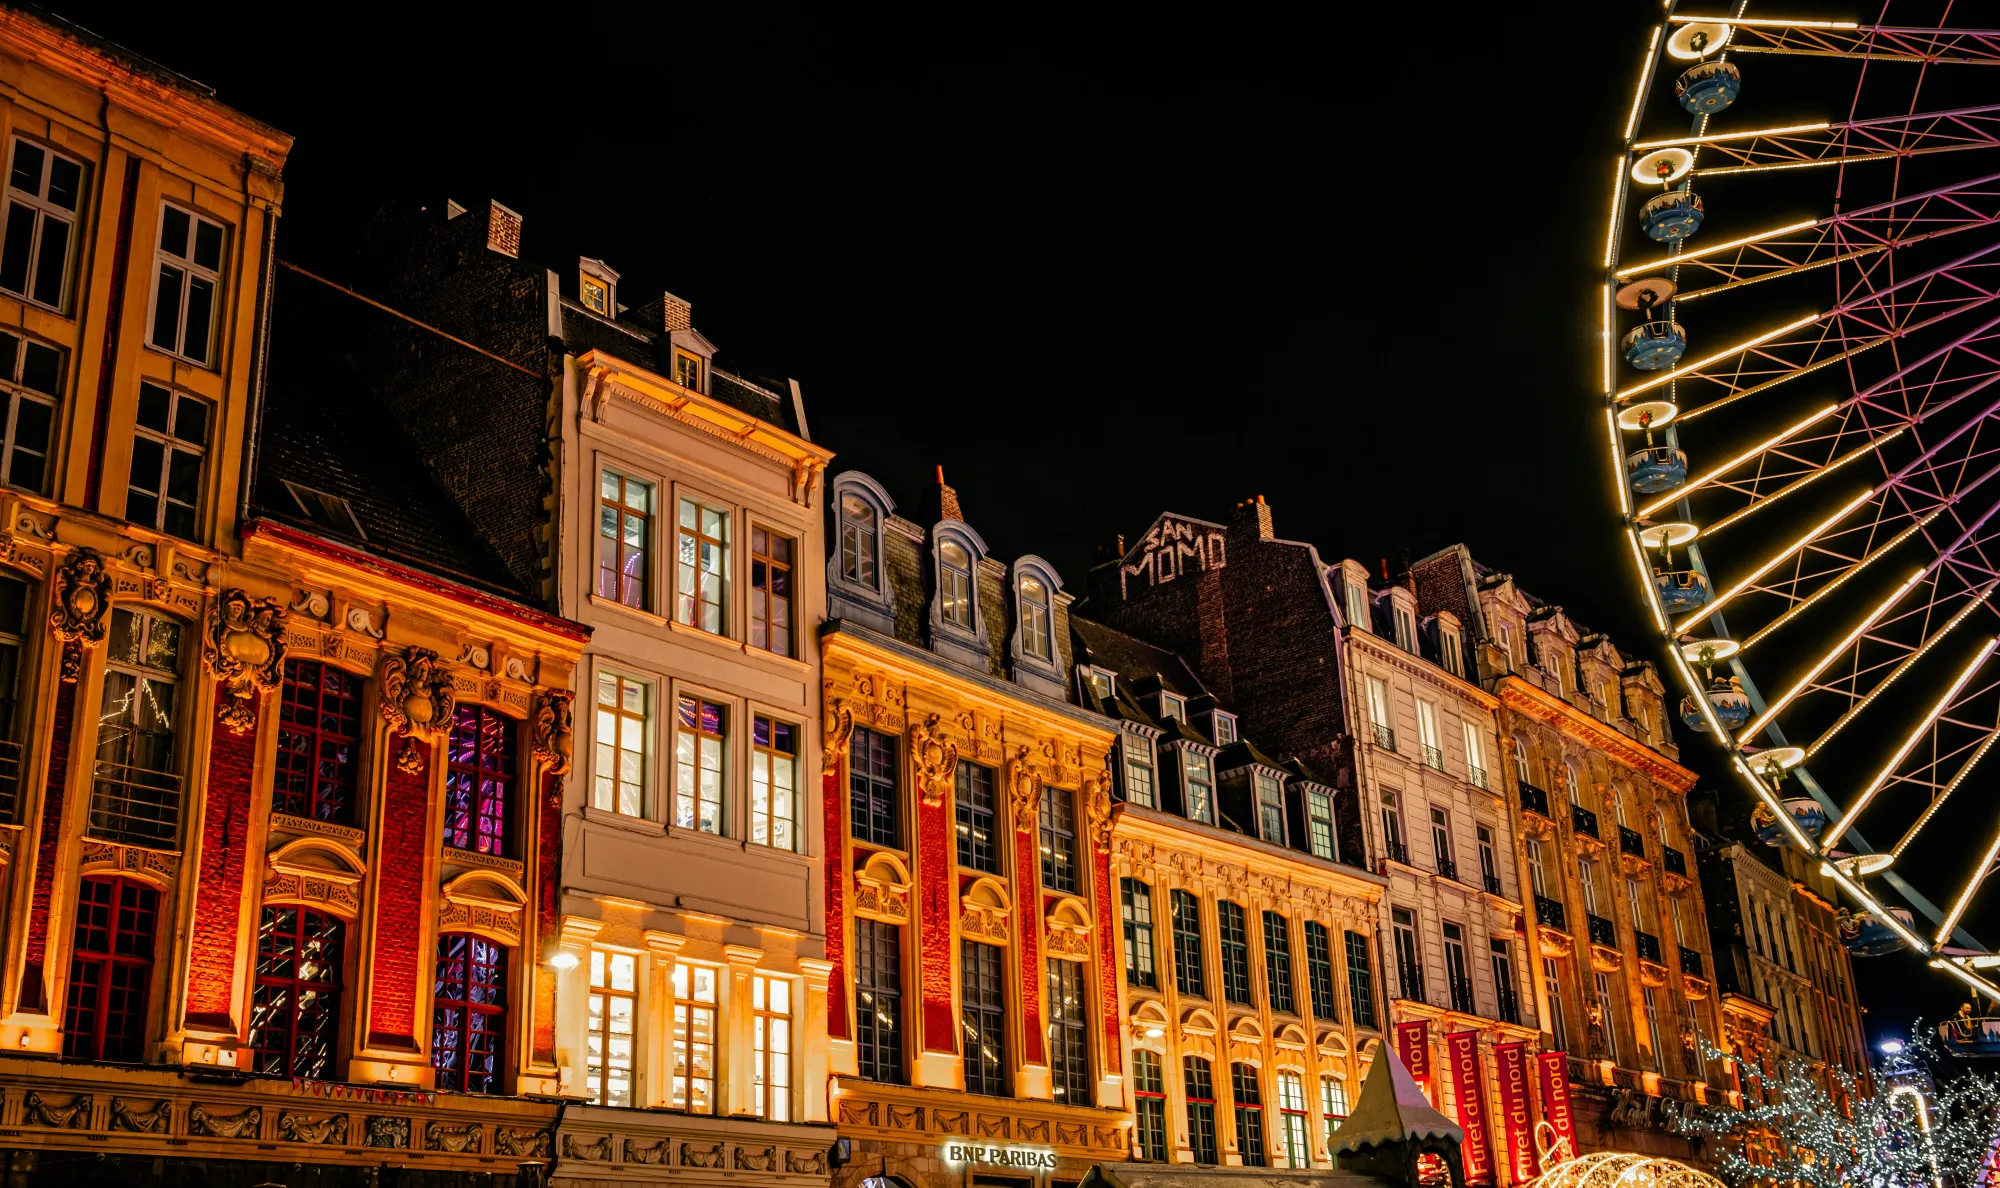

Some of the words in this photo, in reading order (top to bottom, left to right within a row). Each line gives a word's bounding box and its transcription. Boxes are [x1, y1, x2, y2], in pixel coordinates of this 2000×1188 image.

[1144, 518, 1194, 553] SAN
[1120, 531, 1227, 601] MOMO
[1405, 1027, 1423, 1076] nord
[1455, 1037, 1475, 1085] nord
[1503, 1048, 1523, 1094] nord
[1544, 1057, 1565, 1102] nord
[1463, 1091, 1479, 1117] du
[1510, 1098, 1526, 1125] du
[1553, 1104, 1570, 1131] du
[949, 1145, 986, 1162] BNP
[989, 1148, 1057, 1168] PARIBAS
[1466, 1120, 1488, 1177] Furet
[1513, 1127, 1534, 1182] Furet
